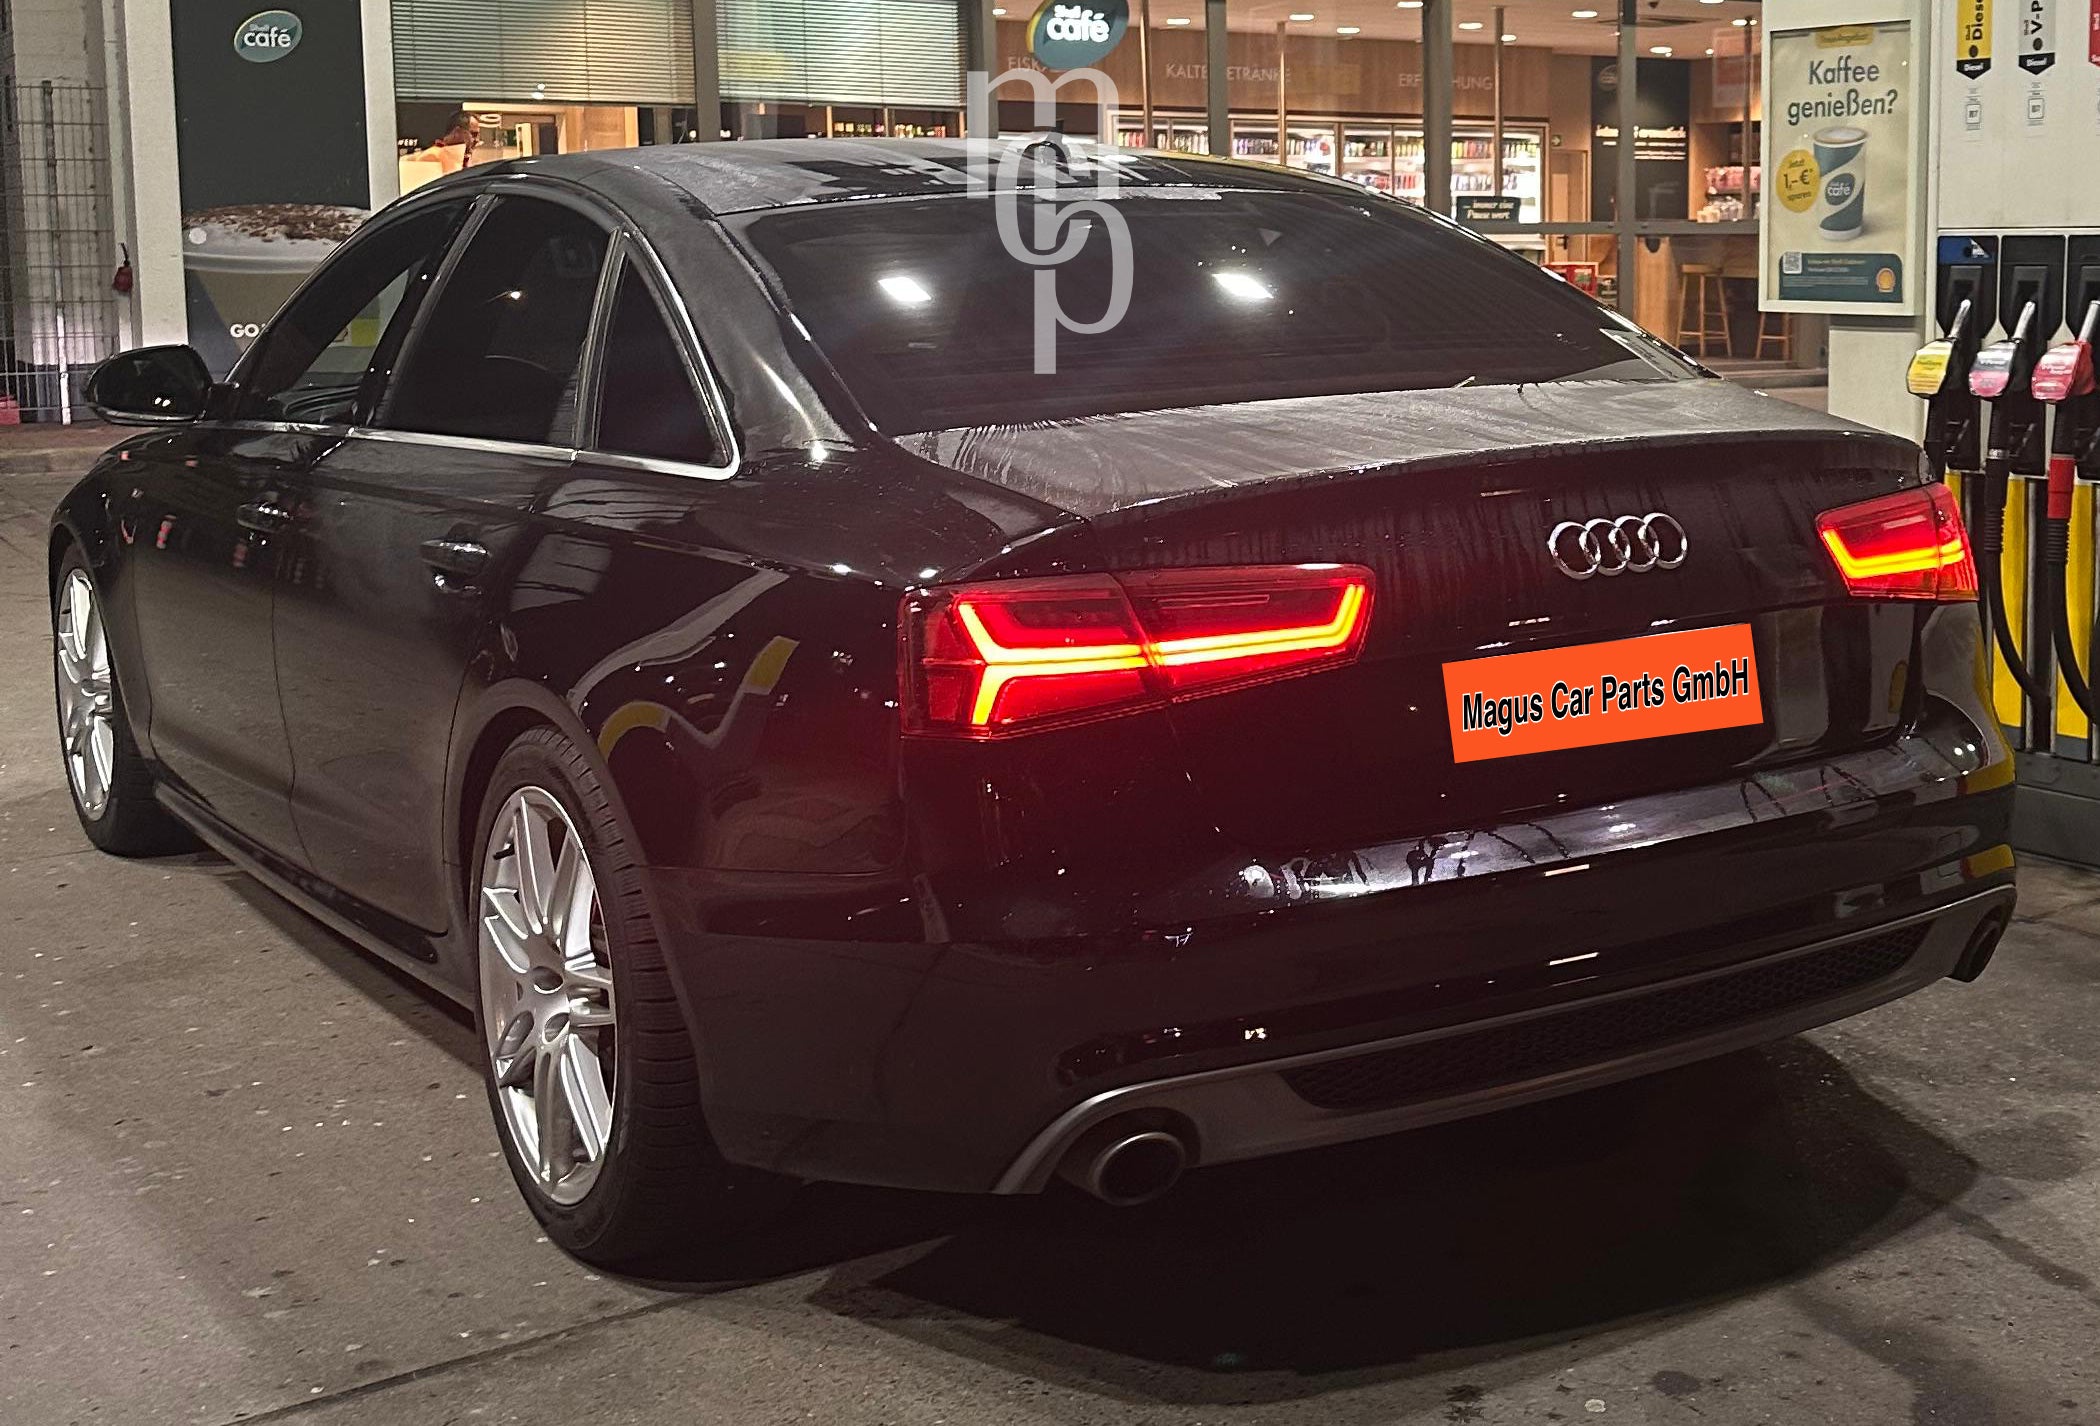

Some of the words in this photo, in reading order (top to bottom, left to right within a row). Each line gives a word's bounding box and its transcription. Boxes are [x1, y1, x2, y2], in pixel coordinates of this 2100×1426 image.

[243, 26, 291, 48] café
[1046, 9, 1110, 42] café
[1971, 0, 1984, 41] Dies
[1808, 54, 1881, 85] Kaffee
[1787, 88, 1898, 127] genießen?
